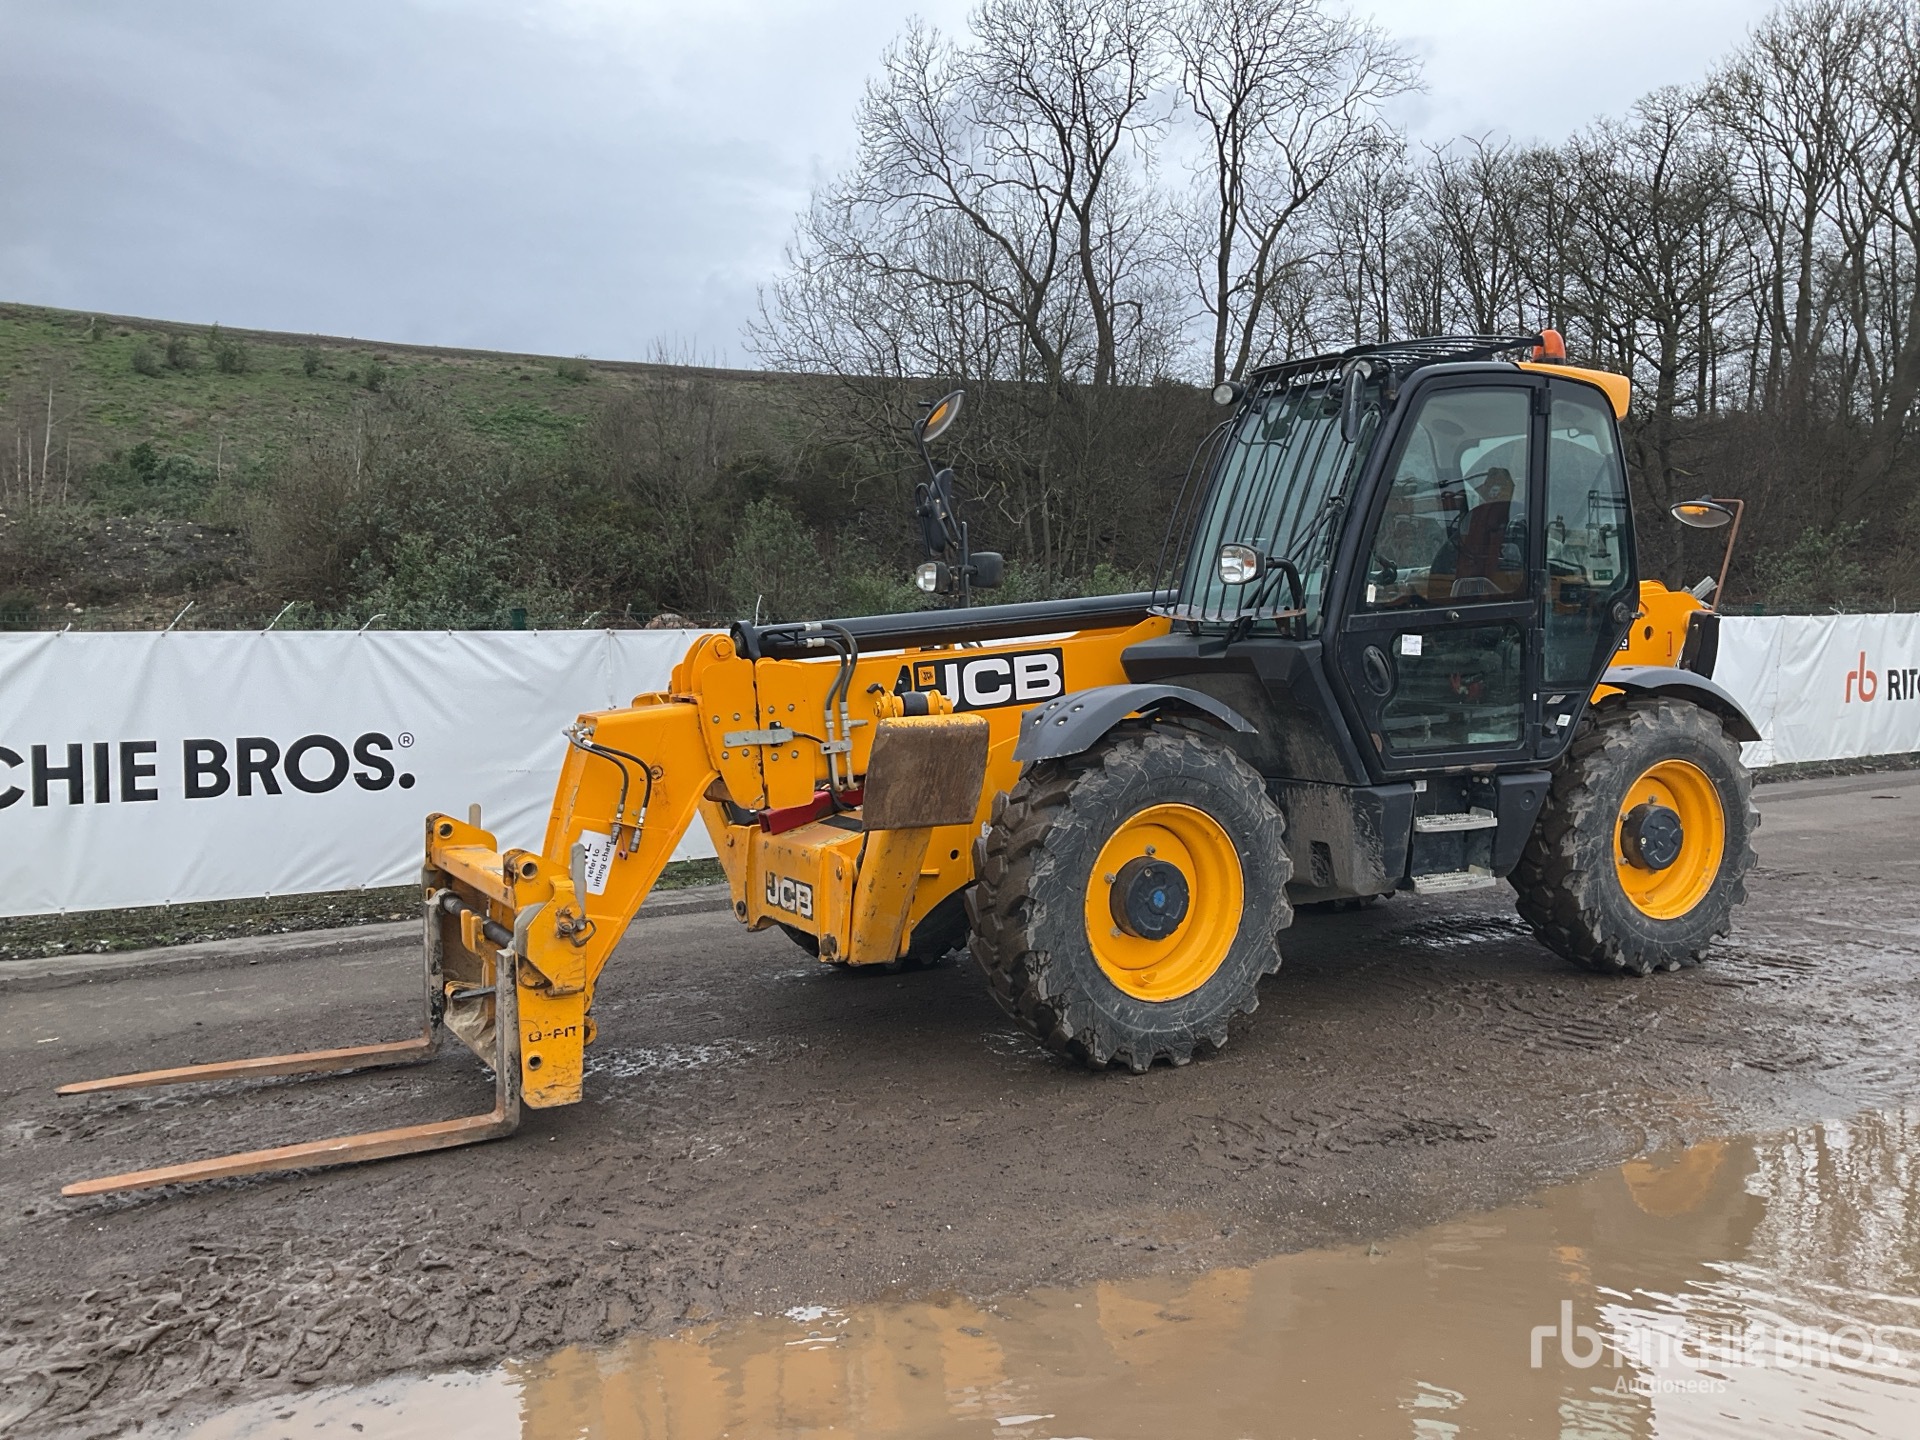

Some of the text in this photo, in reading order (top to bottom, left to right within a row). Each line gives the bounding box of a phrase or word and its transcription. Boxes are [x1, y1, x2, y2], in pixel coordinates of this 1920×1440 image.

[921, 653, 1062, 707] JCB
[1887, 668, 1920, 701] RIT
[588, 860, 597, 878] refer
[593, 849, 600, 857] to
[593, 841, 612, 887] lifting chart
[767, 874, 812, 917] JCB
